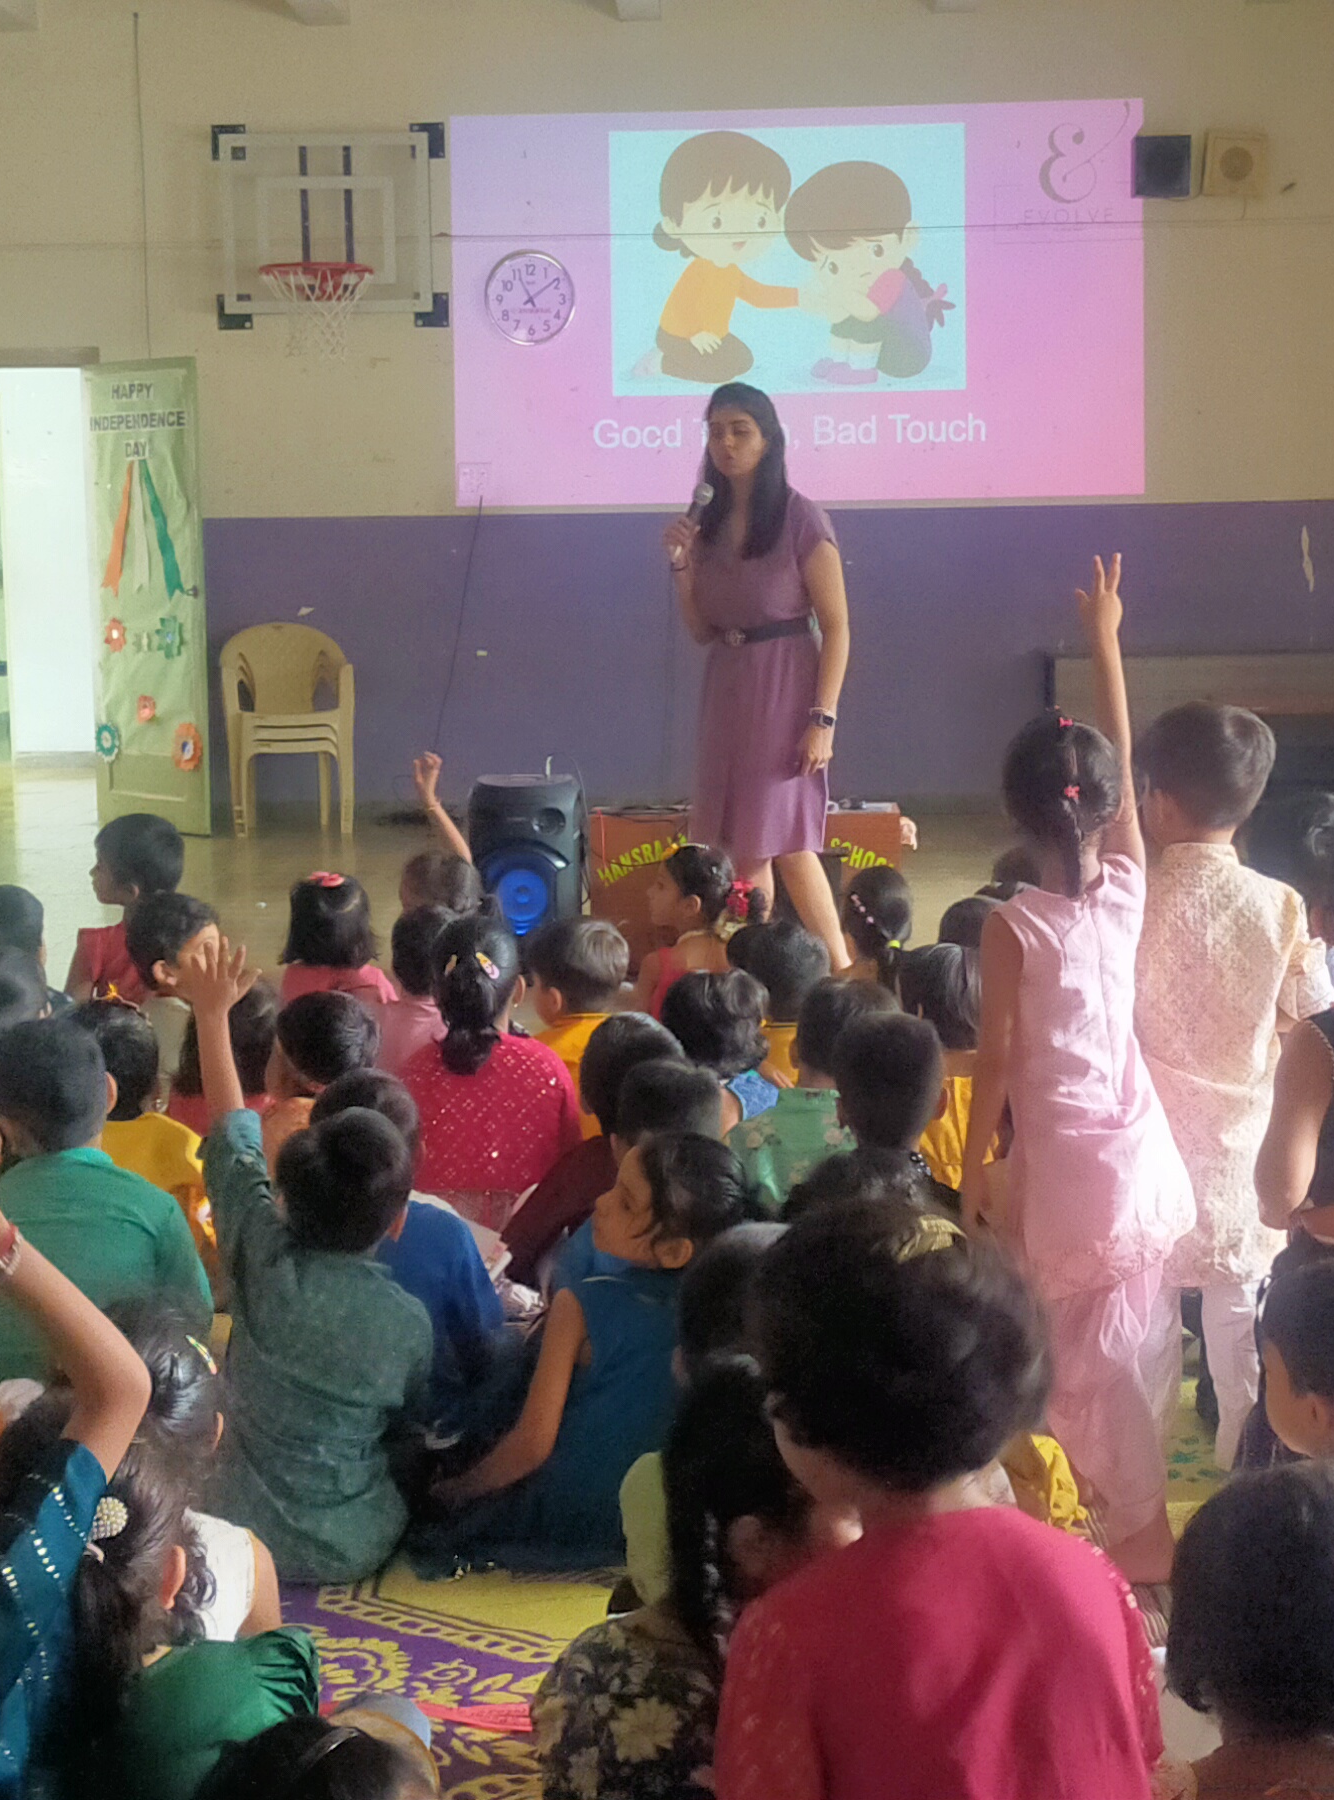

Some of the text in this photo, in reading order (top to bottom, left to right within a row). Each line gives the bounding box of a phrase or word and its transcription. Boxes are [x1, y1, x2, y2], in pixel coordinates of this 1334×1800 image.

[1024, 208, 1114, 224] EVOLVE
[524, 263, 536, 276] 12
[501, 280, 514, 292] 10
[495, 294, 504, 306] 9
[558, 293, 566, 306] 3
[501, 309, 510, 322] 8
[553, 308, 561, 321] 4
[512, 319, 521, 332] 7
[528, 324, 536, 336] 6
[542, 320, 551, 332] 5
[111, 383, 153, 400] HAPPY
[90, 411, 186, 431] INDEPENDENCE
[813, 414, 877, 445] Bad
[887, 412, 987, 443] Touch
[125, 441, 147, 458] DAY
[830, 837, 895, 869] CHO
